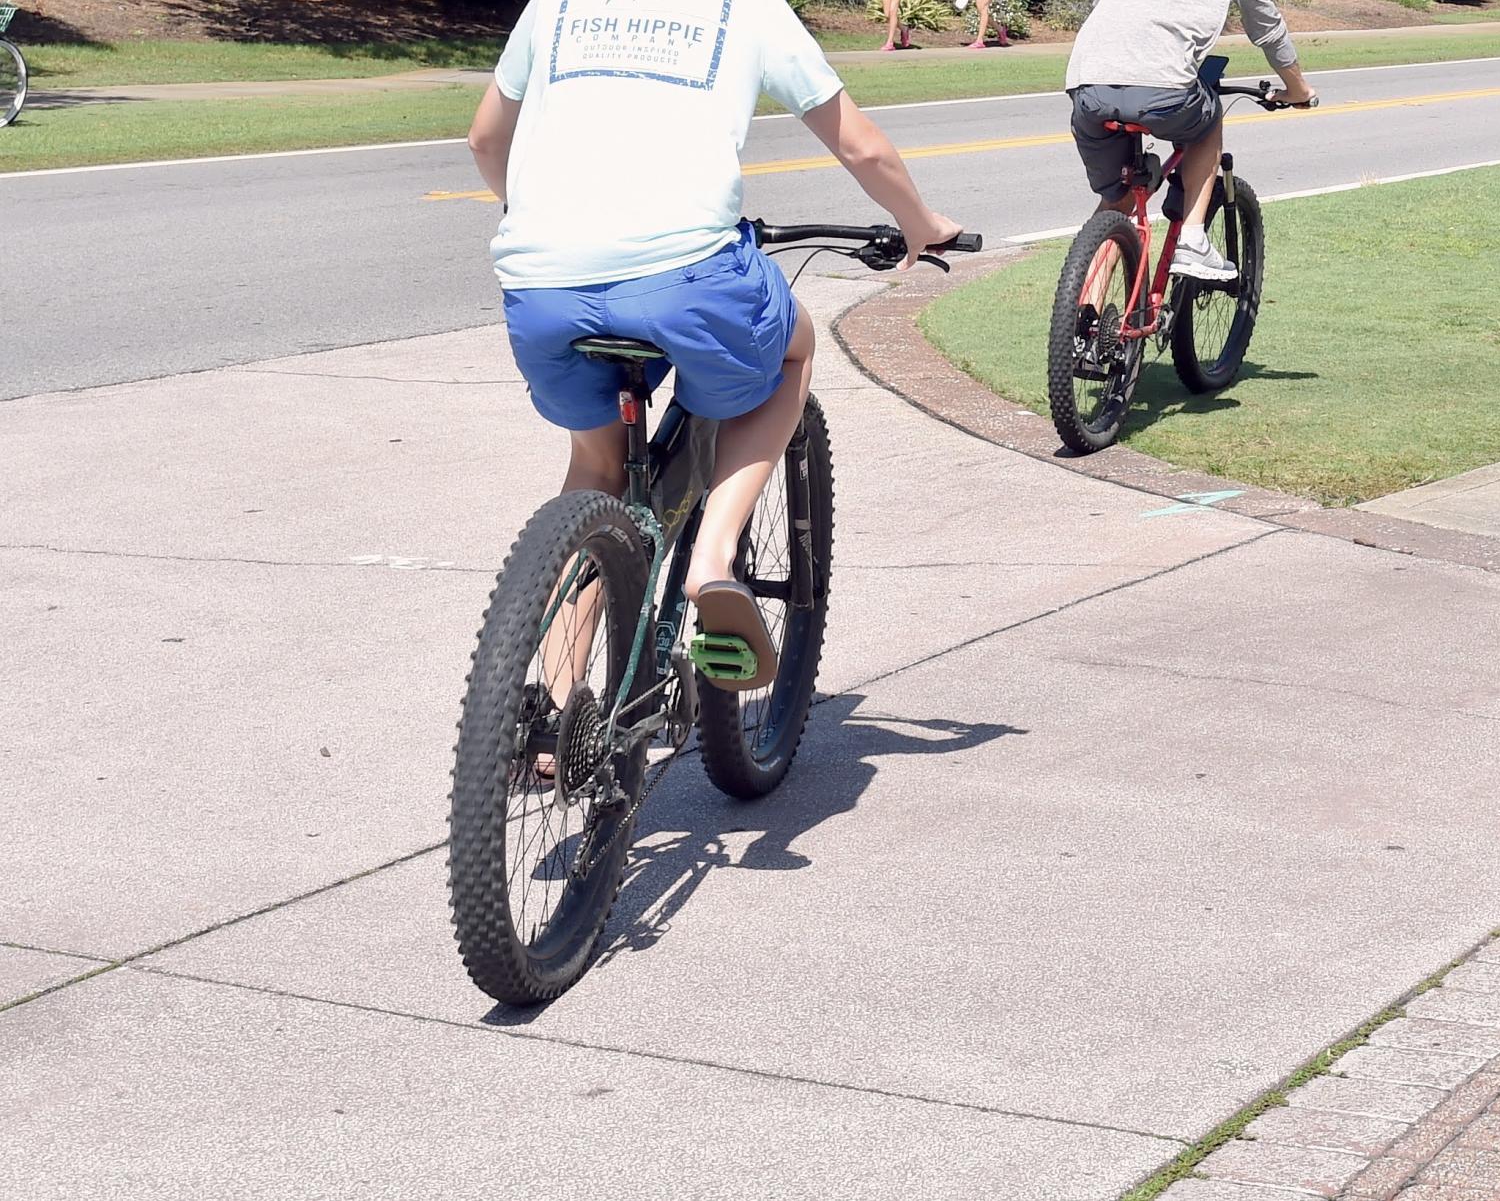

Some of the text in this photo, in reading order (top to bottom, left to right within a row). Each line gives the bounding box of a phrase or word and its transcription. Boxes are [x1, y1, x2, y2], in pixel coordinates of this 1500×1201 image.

[571, 17, 705, 42] FISH HIPPIE
[576, 34, 693, 49] COMPANY
[632, 45, 679, 57] INSPIRED
[627, 53, 678, 65] PRODUCTS
